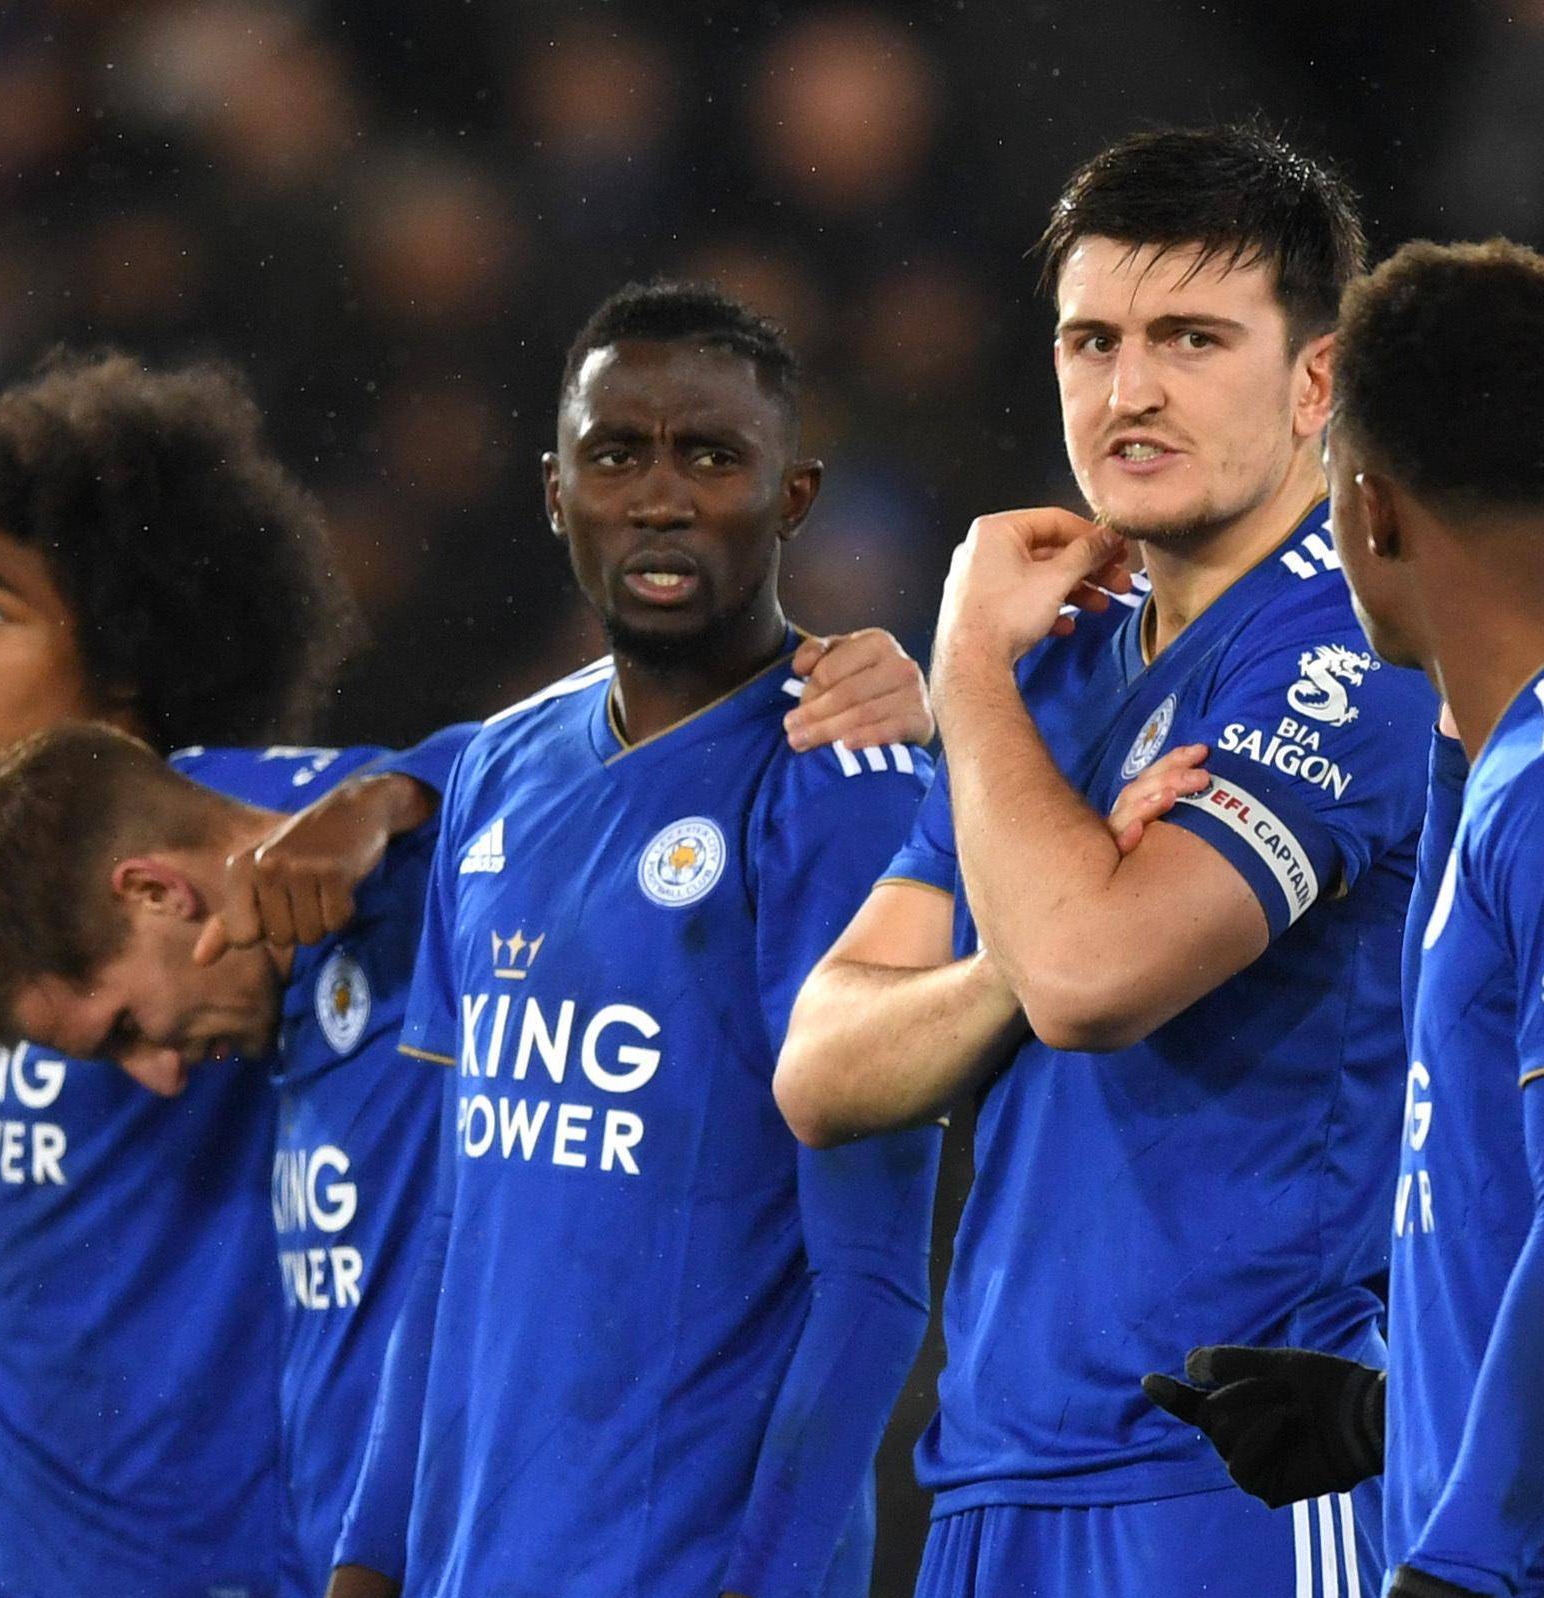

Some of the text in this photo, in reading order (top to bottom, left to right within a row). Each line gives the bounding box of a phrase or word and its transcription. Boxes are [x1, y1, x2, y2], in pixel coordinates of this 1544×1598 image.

[1218, 723, 1353, 801] SAIGON
[1276, 716, 1322, 752] BIA
[1210, 788, 1312, 909] EFL CAPTAIN
[461, 993, 662, 1094] KING
